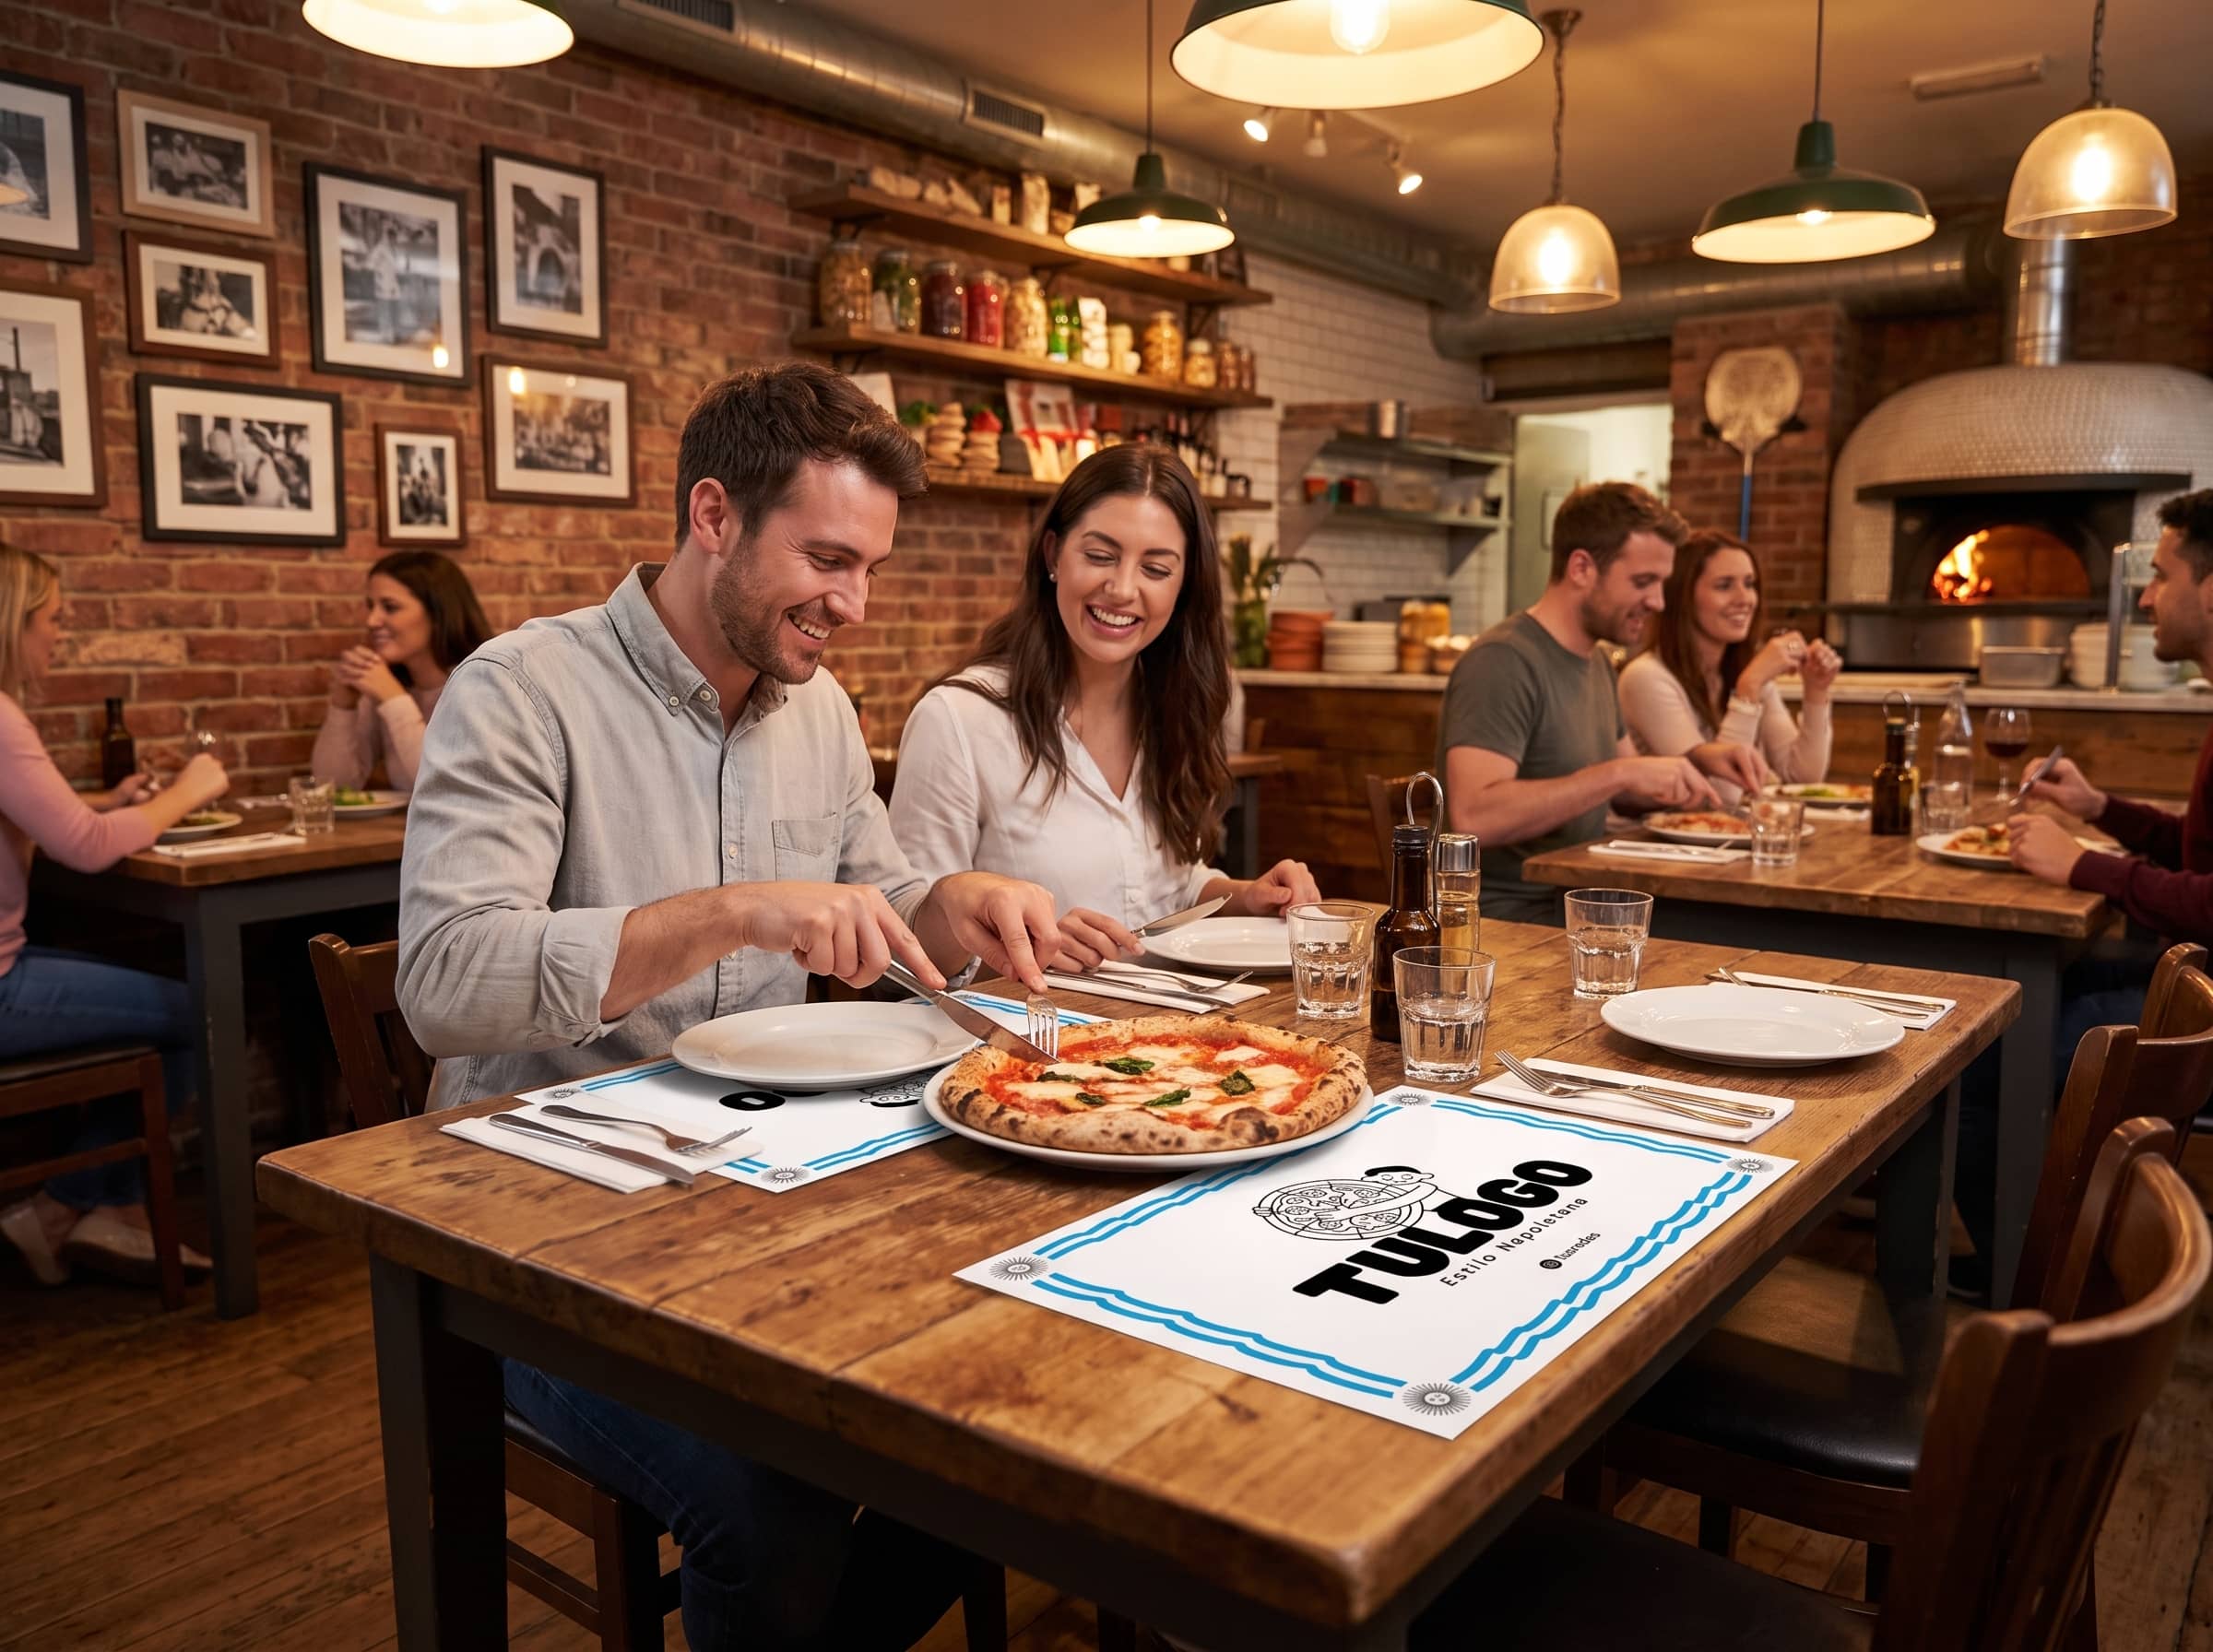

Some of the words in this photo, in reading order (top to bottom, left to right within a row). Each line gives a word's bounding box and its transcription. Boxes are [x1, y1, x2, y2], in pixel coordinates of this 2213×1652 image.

[1293, 1160, 1593, 1304] TULOGO
[1439, 1255, 1497, 1287] Estilo
[1496, 1198, 1588, 1252] Napoletana
